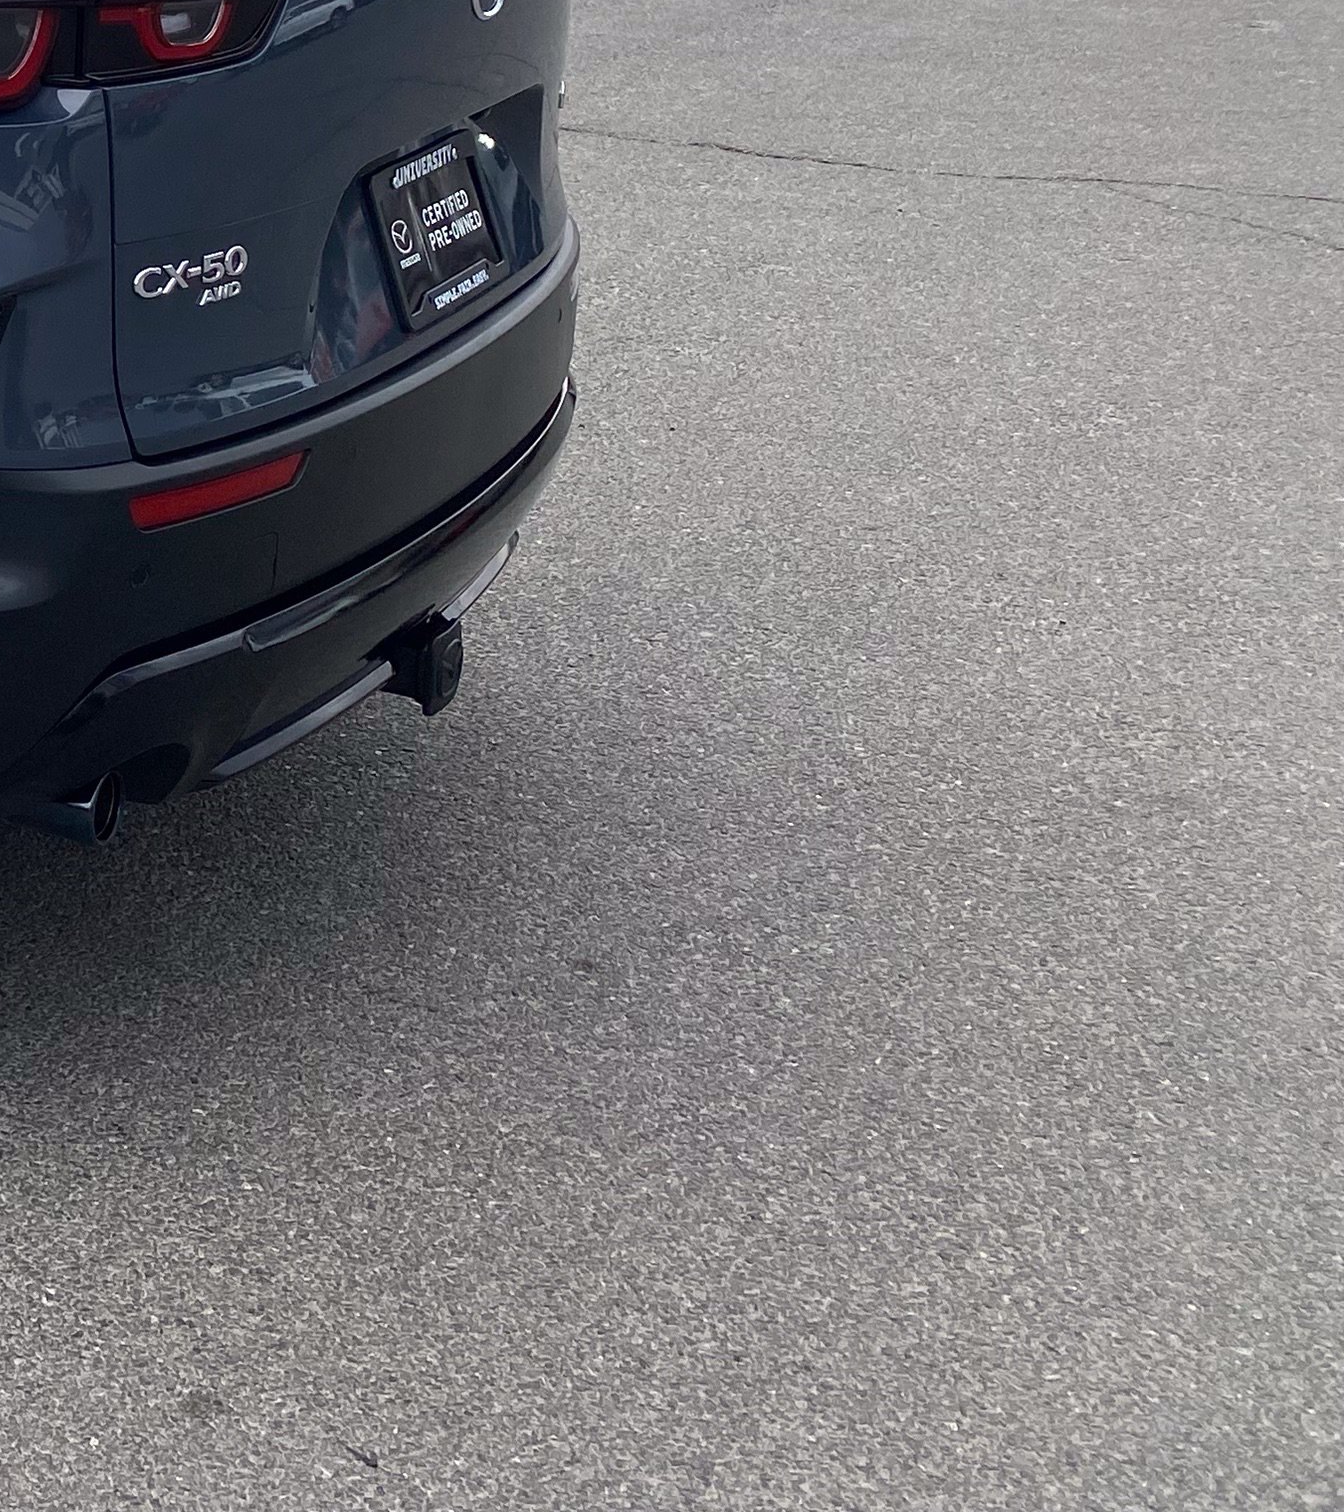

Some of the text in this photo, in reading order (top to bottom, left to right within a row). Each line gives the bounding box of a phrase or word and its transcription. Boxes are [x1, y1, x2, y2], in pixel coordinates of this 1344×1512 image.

[394, 144, 455, 187] UNIVERSITY
[422, 189, 469, 227] CERTIFIED
[428, 209, 482, 251] PRE-OWNED
[134, 245, 249, 299] CX-50
[197, 281, 242, 306] AWD
